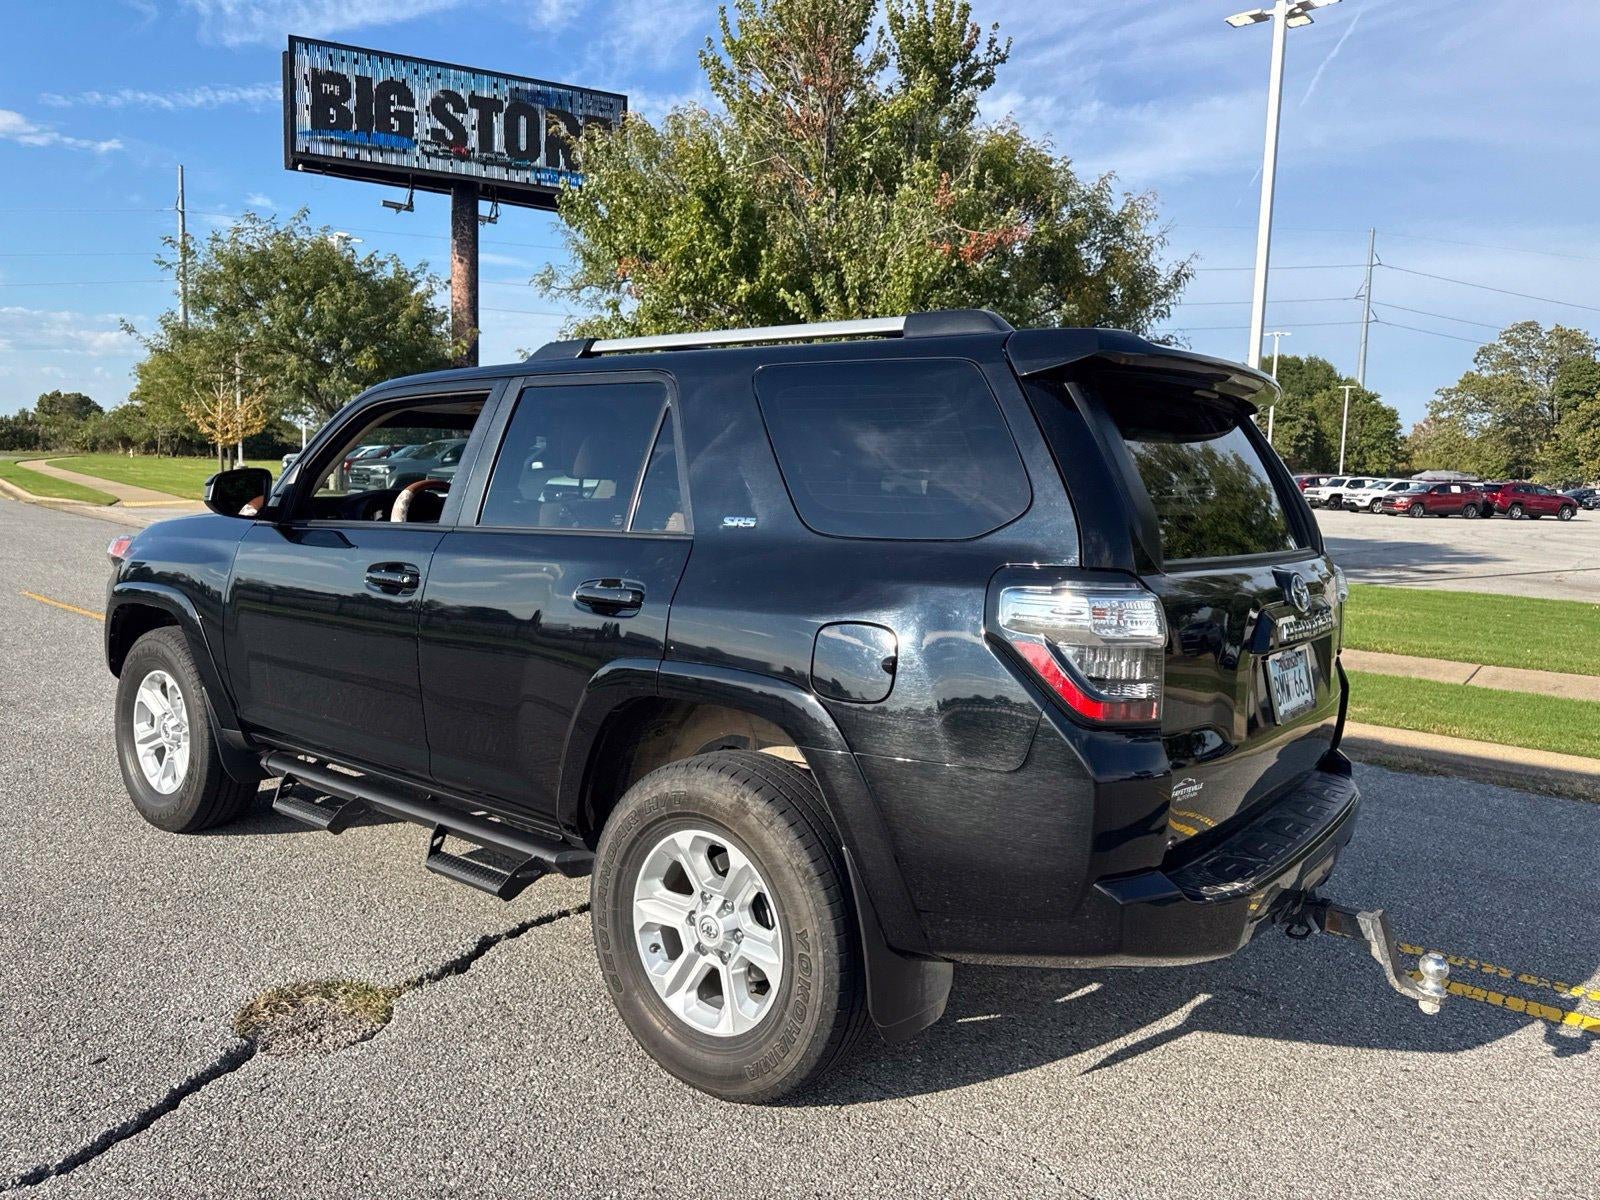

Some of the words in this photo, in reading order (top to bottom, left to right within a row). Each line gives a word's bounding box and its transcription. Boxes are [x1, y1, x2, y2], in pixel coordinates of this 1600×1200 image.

[321, 82, 341, 96] THE
[310, 68, 416, 144] BIG
[429, 89, 613, 171] STOR
[723, 516, 756, 528] SR5
[1171, 782, 1204, 798] FAYETTEVILLE
[596, 812, 641, 995] GEOLANDAR
[641, 789, 688, 817] H/T
[744, 928, 813, 1082] YOKOHAMA
